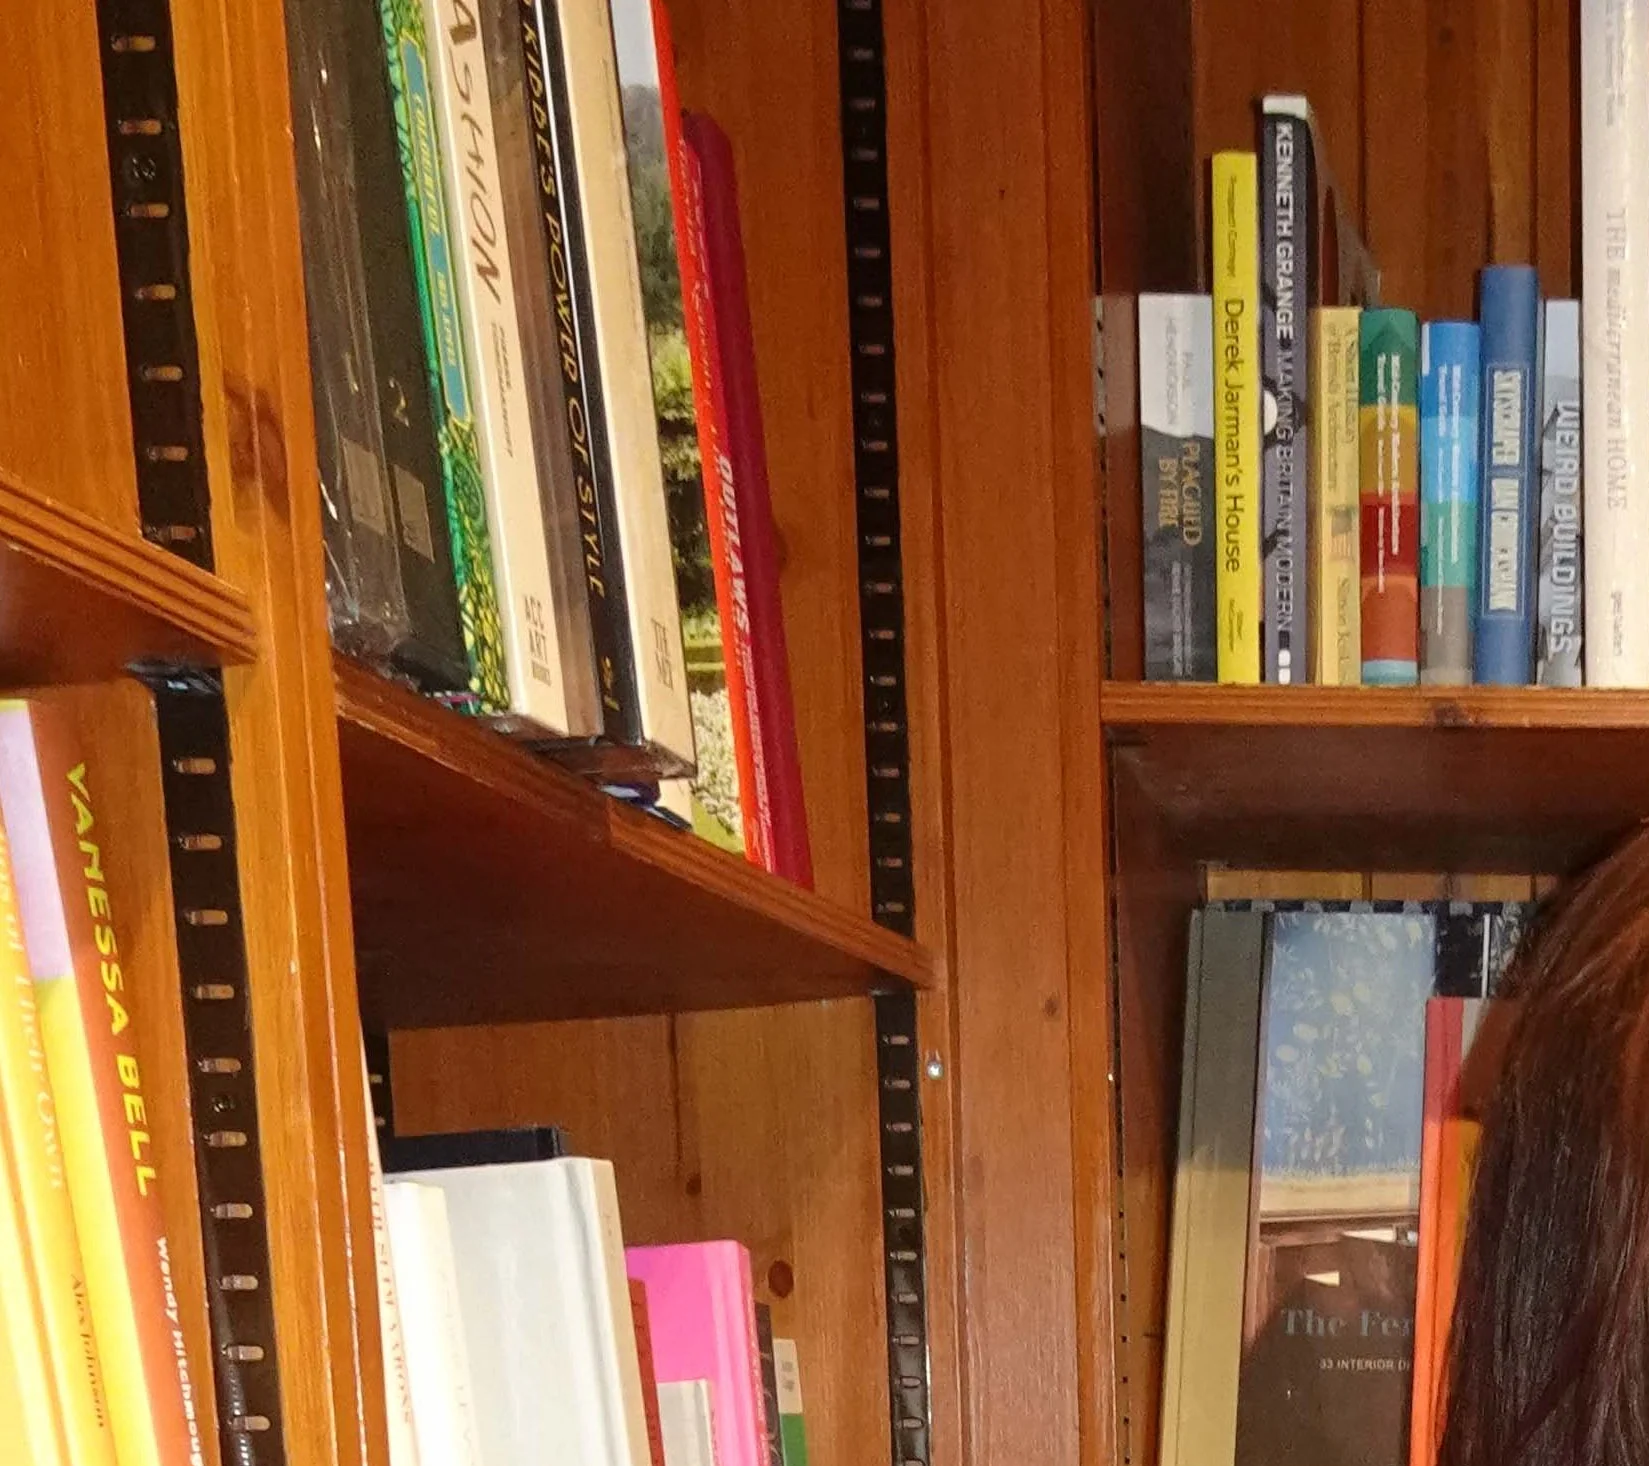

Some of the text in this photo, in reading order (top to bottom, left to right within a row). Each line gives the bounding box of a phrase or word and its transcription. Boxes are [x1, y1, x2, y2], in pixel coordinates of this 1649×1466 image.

[522, 20, 604, 598] KIBBE'S POWER OF STYLE
[1223, 299, 1244, 571] Derek Jarman's House
[1275, 123, 1294, 631] KENNETH GRANGE MAKING BRITAIN MODERN
[1606, 208, 1628, 511] THE HOME
[718, 455, 750, 635] OUTLAWS
[1157, 458, 1179, 480] BY
[1551, 399, 1579, 653] WEIRD BUILDINGS
[65, 762, 157, 1196] VANESSA BELL
[71, 1274, 90, 1324] Alex
[155, 1236, 181, 1322] Wendy
[1337, 1357, 1394, 1370] INTERIOR
